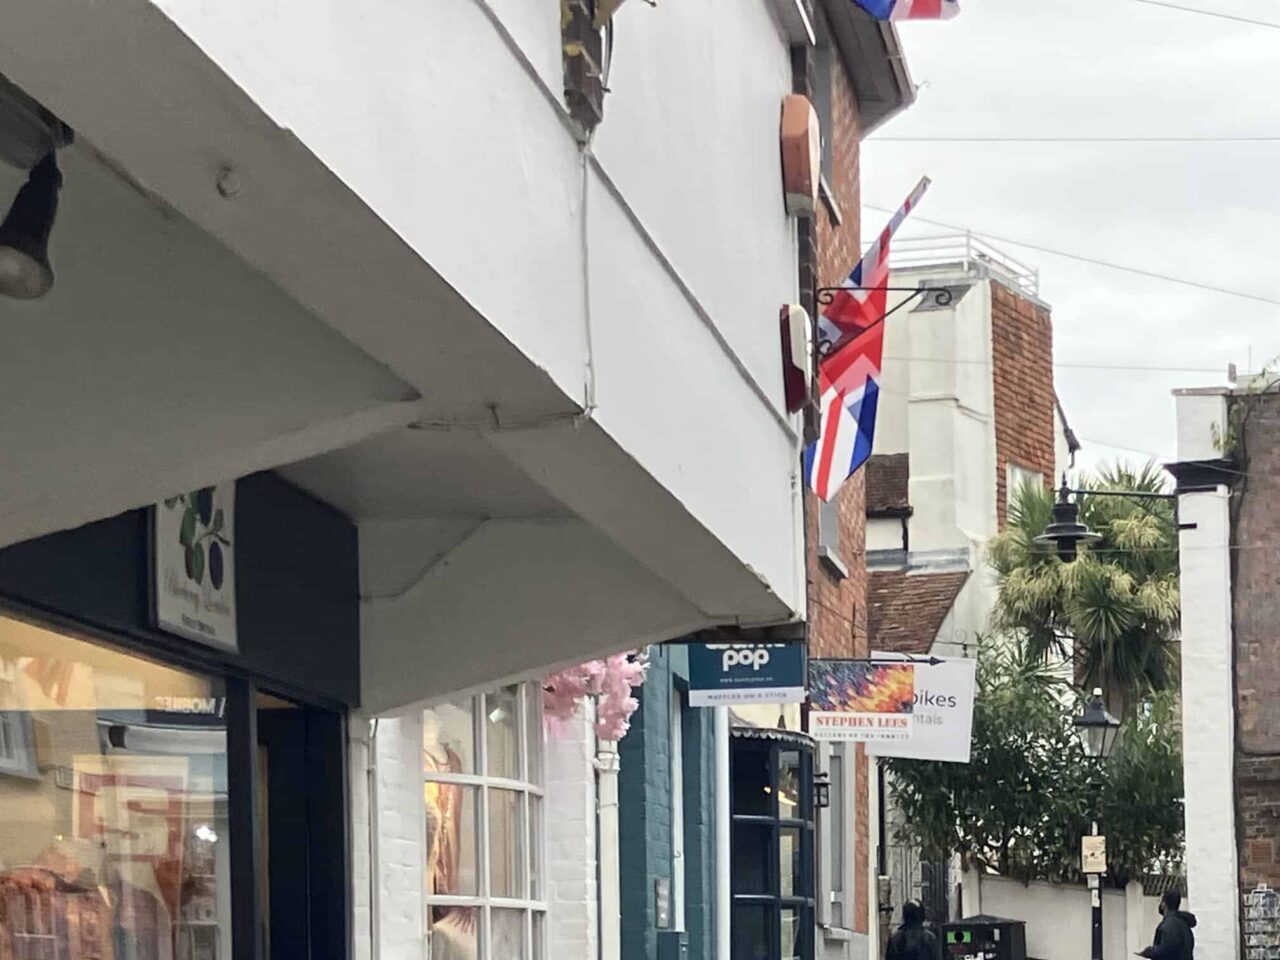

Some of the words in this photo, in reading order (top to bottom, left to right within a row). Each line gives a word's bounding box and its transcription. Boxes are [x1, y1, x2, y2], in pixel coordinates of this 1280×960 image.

[722, 648, 770, 672] pop
[816, 716, 874, 727] STEPHEN
[878, 717, 908, 728] LEES
